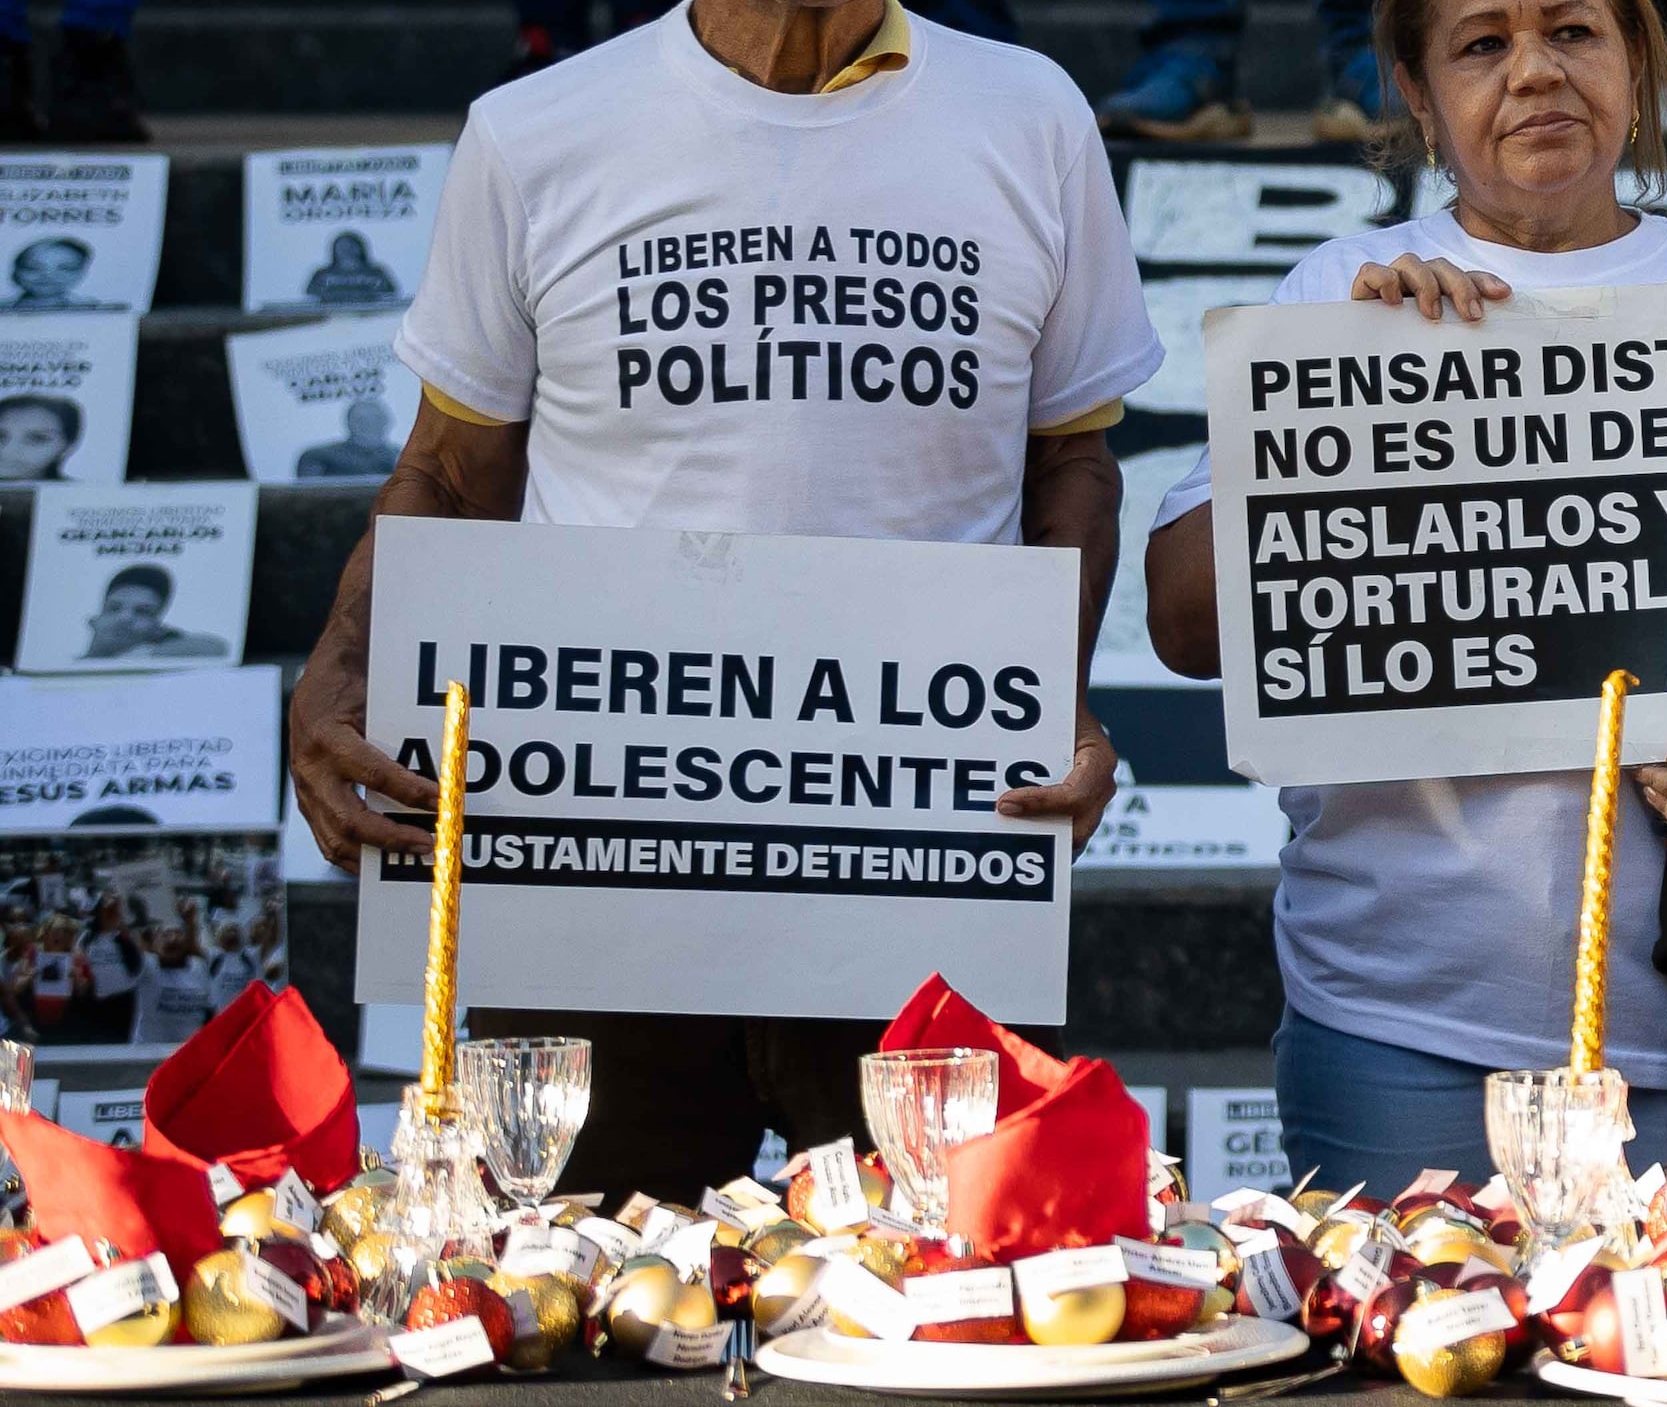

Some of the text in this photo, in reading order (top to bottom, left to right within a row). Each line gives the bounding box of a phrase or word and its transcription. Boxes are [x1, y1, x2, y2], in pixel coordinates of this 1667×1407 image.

[619, 225, 981, 279] LIBEREN A TODOS
[619, 274, 980, 337] LOS PRESOS
[619, 326, 980, 410] POLÍTICOS
[1250, 345, 1524, 412] PENSAR
[1252, 424, 1352, 481] NO
[1372, 417, 1455, 474] ES
[1473, 412, 1569, 469] UN
[1254, 491, 1642, 565] AISLARLOS
[416, 641, 1043, 733] LIBEREN A LOS
[1262, 632, 1539, 703] SÍ LO ES
[0, 736, 234, 766] XIGIMOS LIBERTAD
[0, 770, 237, 805] ESUS ARMAS
[384, 832, 1047, 887] INUSTAMENTE DETENIDOS
